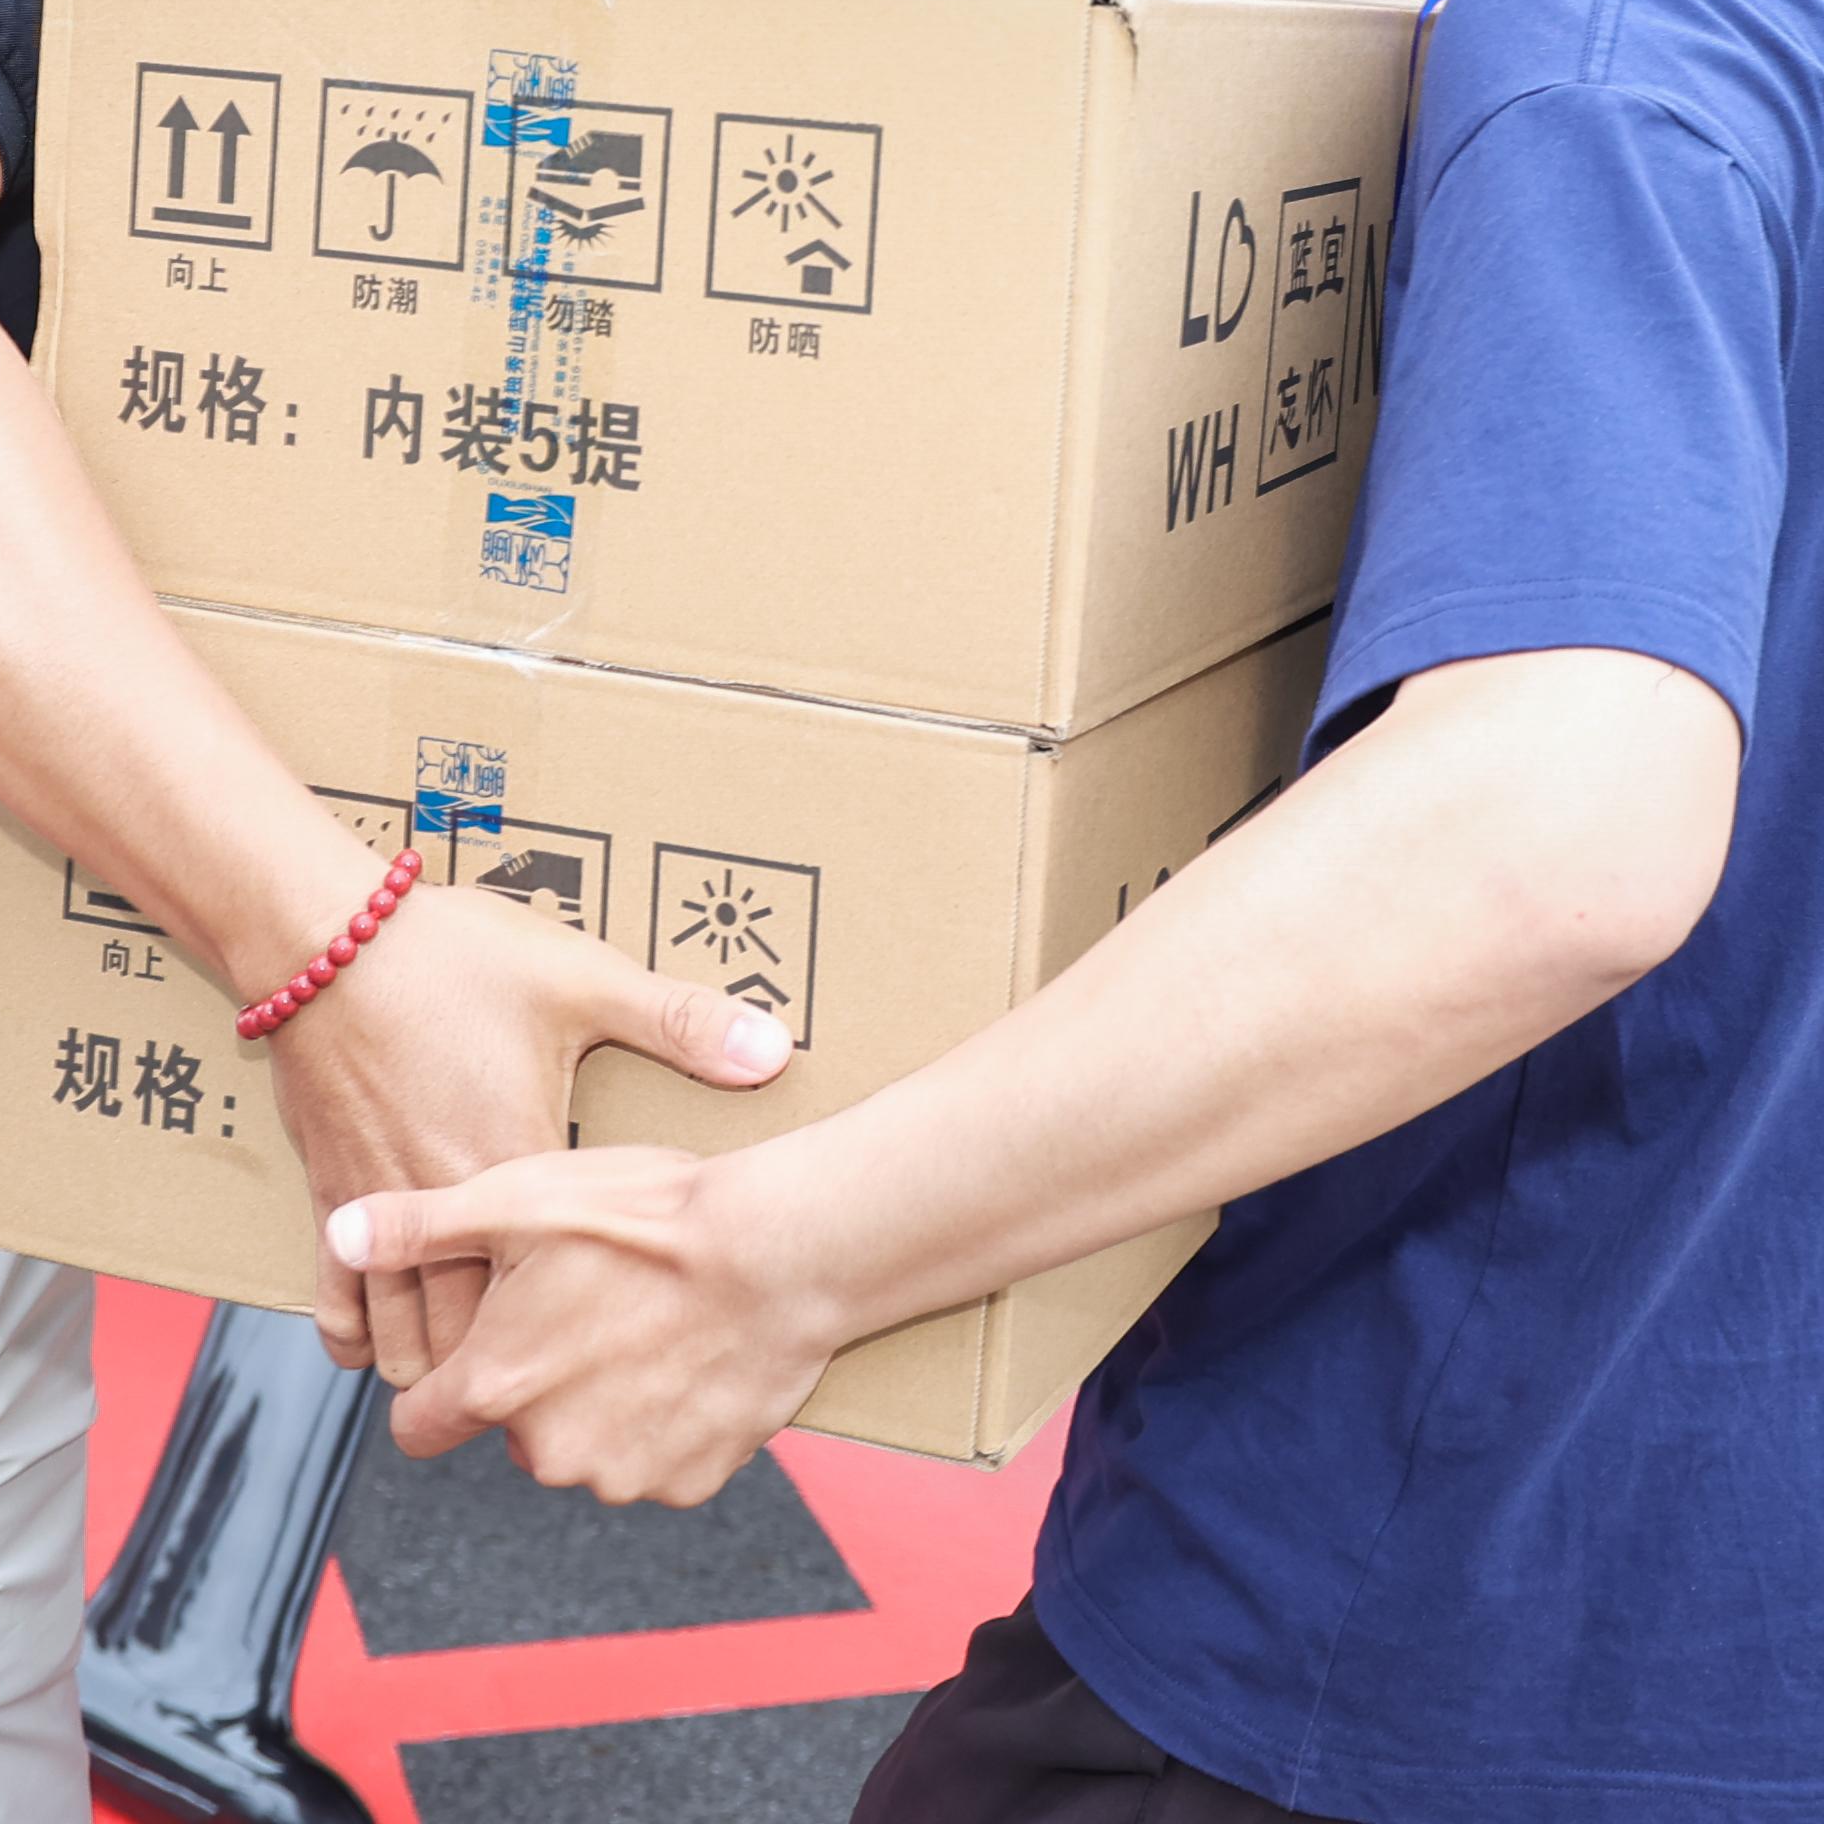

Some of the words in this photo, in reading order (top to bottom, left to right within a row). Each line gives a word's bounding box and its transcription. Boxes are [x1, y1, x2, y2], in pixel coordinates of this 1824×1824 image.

[166, 253, 229, 293] 向上
[351, 273, 420, 316] 防潮
[545, 293, 615, 338] 勿踏
[748, 316, 823, 360] 防晒
[1166, 402, 1240, 534] WH
[102, 939, 165, 982] 向上
